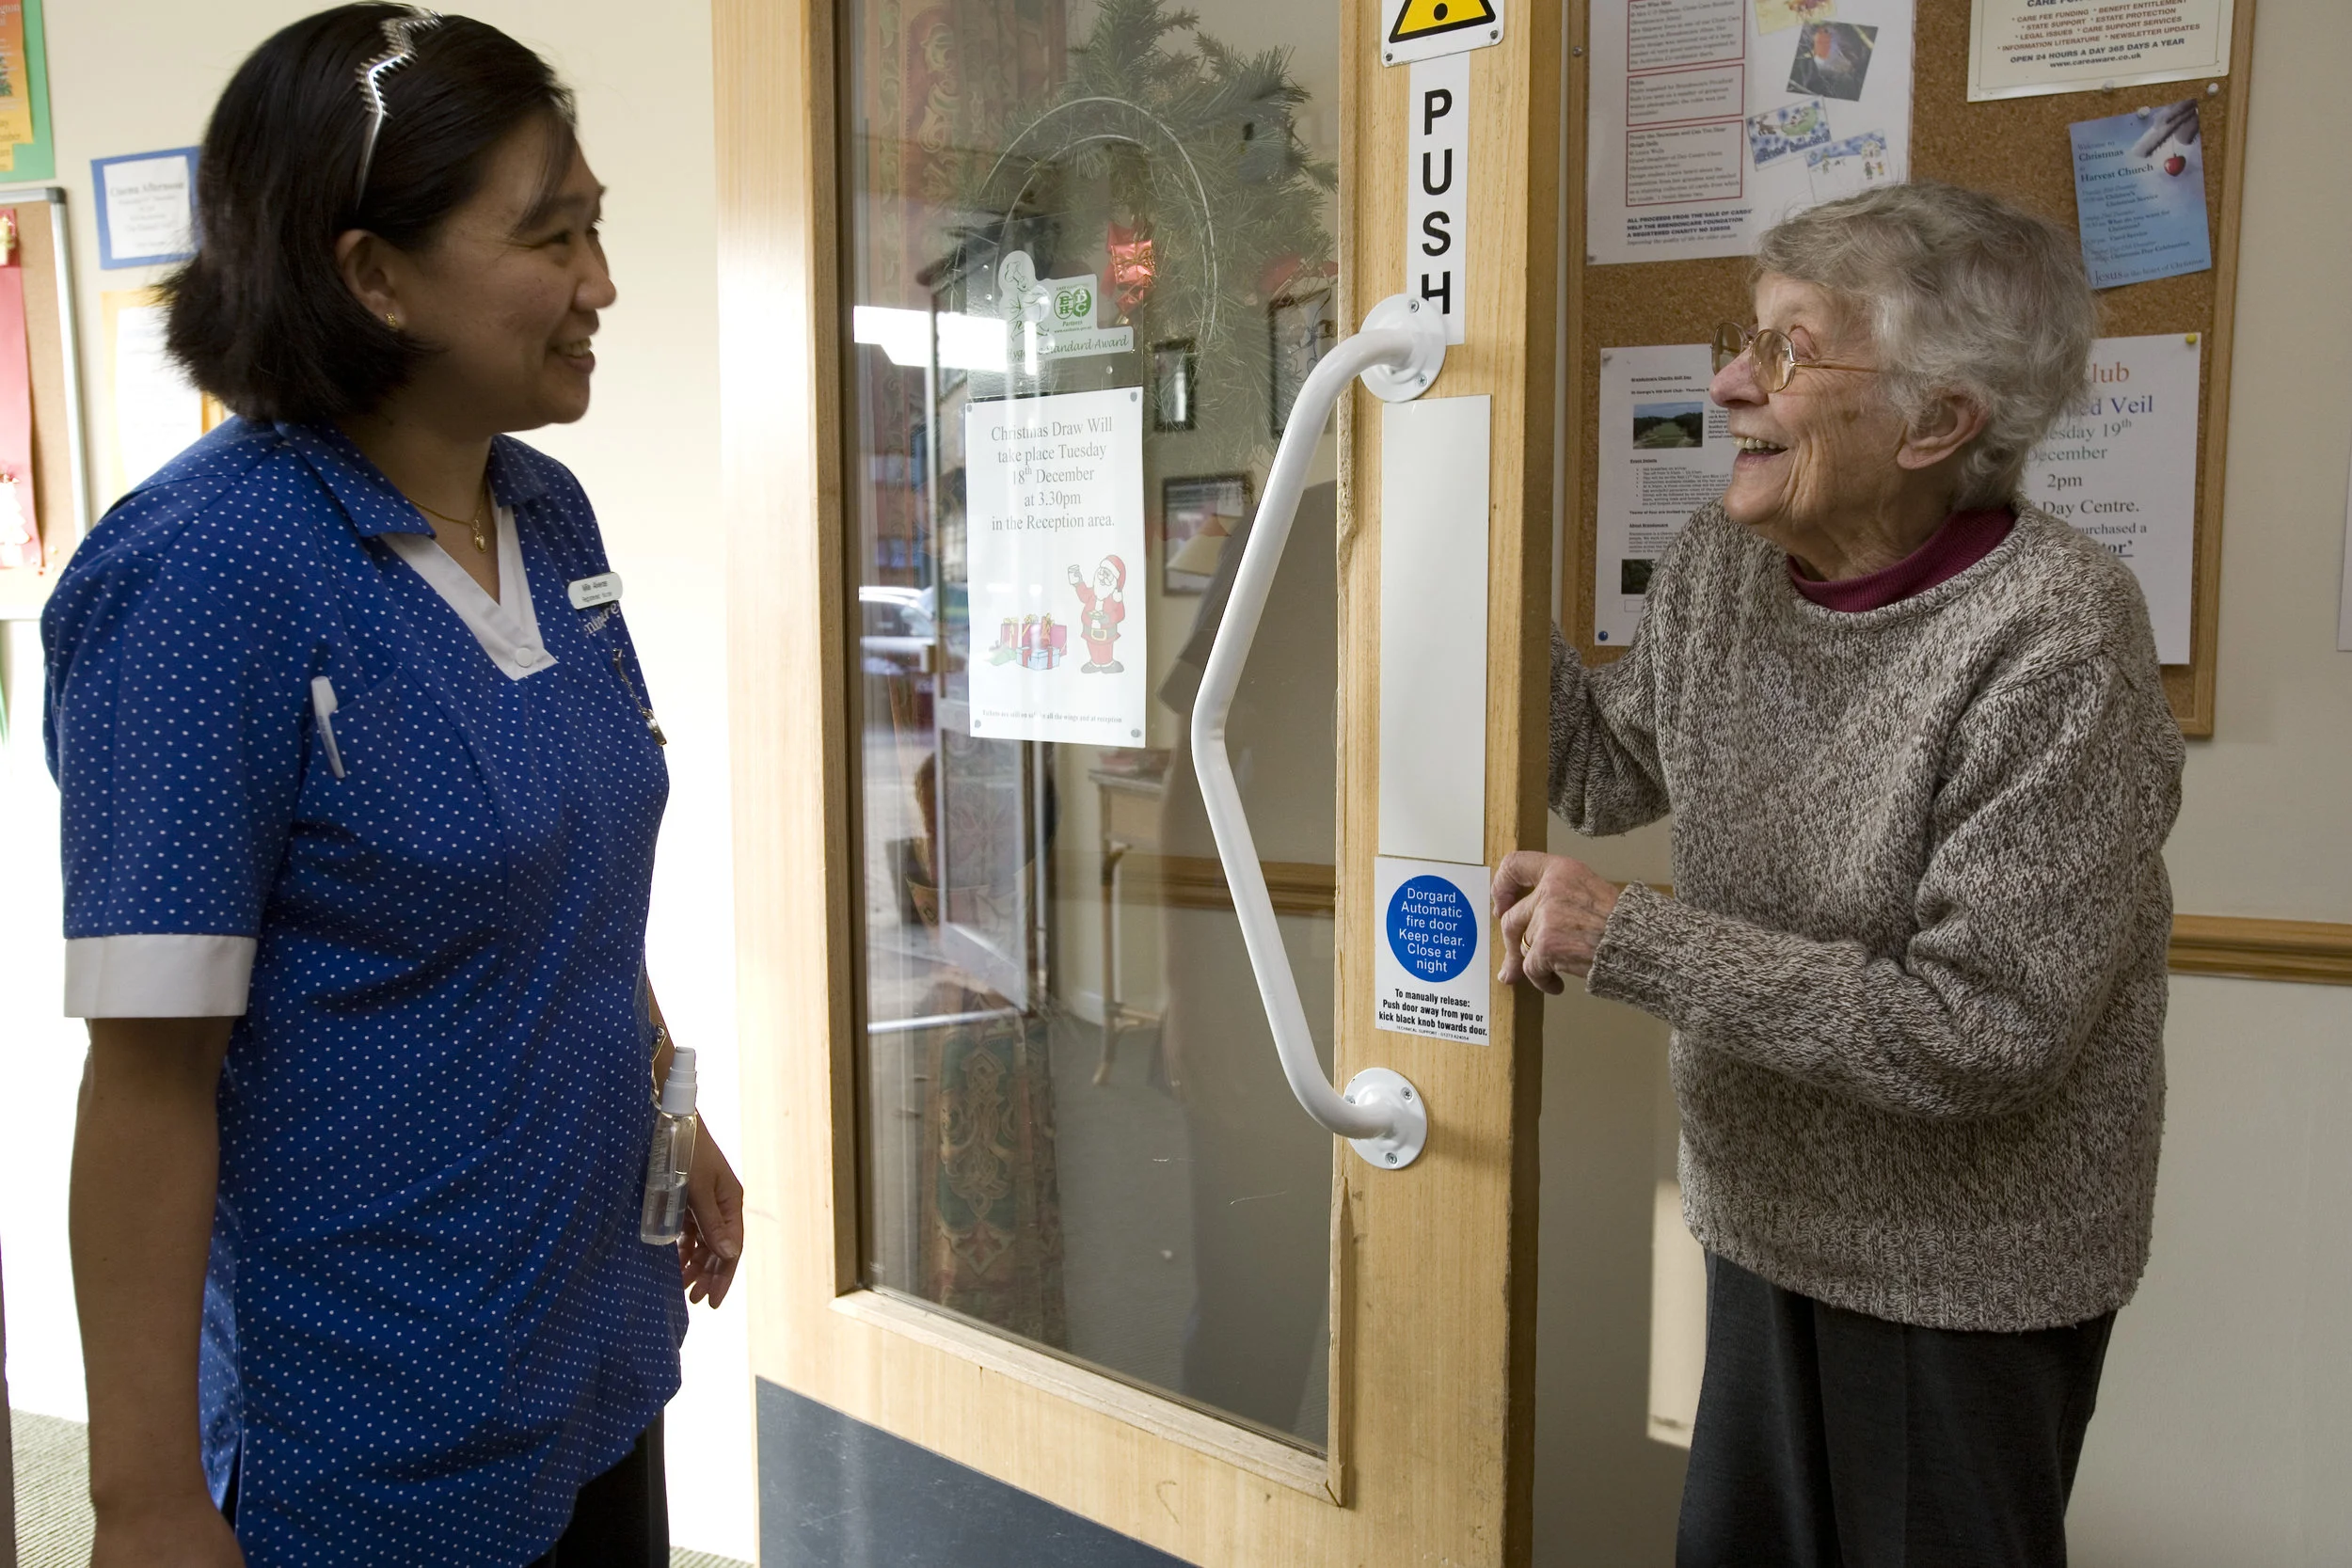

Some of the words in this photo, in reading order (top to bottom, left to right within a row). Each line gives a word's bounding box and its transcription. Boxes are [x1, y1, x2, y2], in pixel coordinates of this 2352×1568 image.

[2051, 19, 2087, 28] SUPPORT
[2096, 14, 2124, 23] ESTATE
[2126, 8, 2177, 19] PROTECTION
[2055, 9, 2089, 18] FUNDING
[2098, 5, 2130, 13] BENEFIT
[2020, 32, 2043, 40] LEGAL
[2045, 29, 2074, 38] ISSUES
[2082, 25, 2104, 34] CARE
[2106, 21, 2141, 31] SUPPORT
[2143, 16, 2183, 26] SERVICES
[2002, 41, 2053, 52] INFORMATION
[2055, 36, 2100, 46] LITERATURE
[2109, 28, 2162, 40] NEWSLETTER
[2164, 24, 2201, 34] UPDATES
[2048, 50, 2078, 59] HOURS
[2127, 42, 2151, 51] DAYS
[2160, 38, 2185, 46] YEAR
[2049, 52, 2141, 68] www.careaware.co.uk
[2078, 150, 2124, 162] Christmas
[2081, 172, 2115, 182] Harvest
[2118, 163, 2154, 177] Church
[1422, 88, 1453, 314] PUSH
[1045, 339, 1093, 356] tandard
[1093, 334, 1129, 350] Award
[2092, 361, 2130, 384] lub
[2111, 395, 2153, 414] Veil
[991, 424, 1049, 441] Christmas
[1052, 421, 1084, 437] Draw
[1088, 417, 1113, 433] Will
[2043, 424, 2096, 442] esday
[2103, 419, 2132, 437] 19th
[998, 448, 1022, 464] take
[1025, 447, 1056, 466] place
[1058, 442, 1106, 460] Tuesday
[2027, 447, 2107, 463] December
[1013, 465, 1032, 485] 18th
[1036, 466, 1095, 483] December
[2047, 474, 2083, 491] 2pm
[1024, 494, 1035, 507] at
[1038, 490, 1081, 509] 3.30pm
[2042, 500, 2075, 518] Day
[2080, 499, 2139, 515] Centre.
[992, 516, 1003, 531] in
[1007, 515, 1023, 531] the
[1026, 514, 1084, 532] Reception
[1088, 515, 1115, 527] area.
[2139, 525, 2147, 534] a
[1407, 887, 1456, 904] Dorgard
[1401, 901, 1463, 919] Automatic
[1406, 915, 1425, 928] fire
[1429, 917, 1457, 931] door
[1399, 928, 1429, 944] Keep
[1433, 932, 1465, 947] clear.
[1407, 942, 1441, 958] Close
[1445, 947, 1456, 960] at
[1416, 958, 1448, 974] night
[1395, 989, 1403, 998] To
[1406, 991, 1438, 1005] manually
[1440, 995, 1470, 1007] release:
[1383, 999, 1400, 1010] Push
[1402, 1002, 1418, 1013] door
[1421, 1006, 1439, 1018] away
[1441, 1007, 1458, 1019] from
[1460, 1012, 1473, 1022] you
[1475, 1014, 1484, 1022] or
[1378, 1011, 1394, 1022] kick
[1395, 1014, 1416, 1025] black
[1418, 1017, 1436, 1028] knob
[1438, 1020, 1468, 1033] towards
[1469, 1025, 1487, 1036] door.
